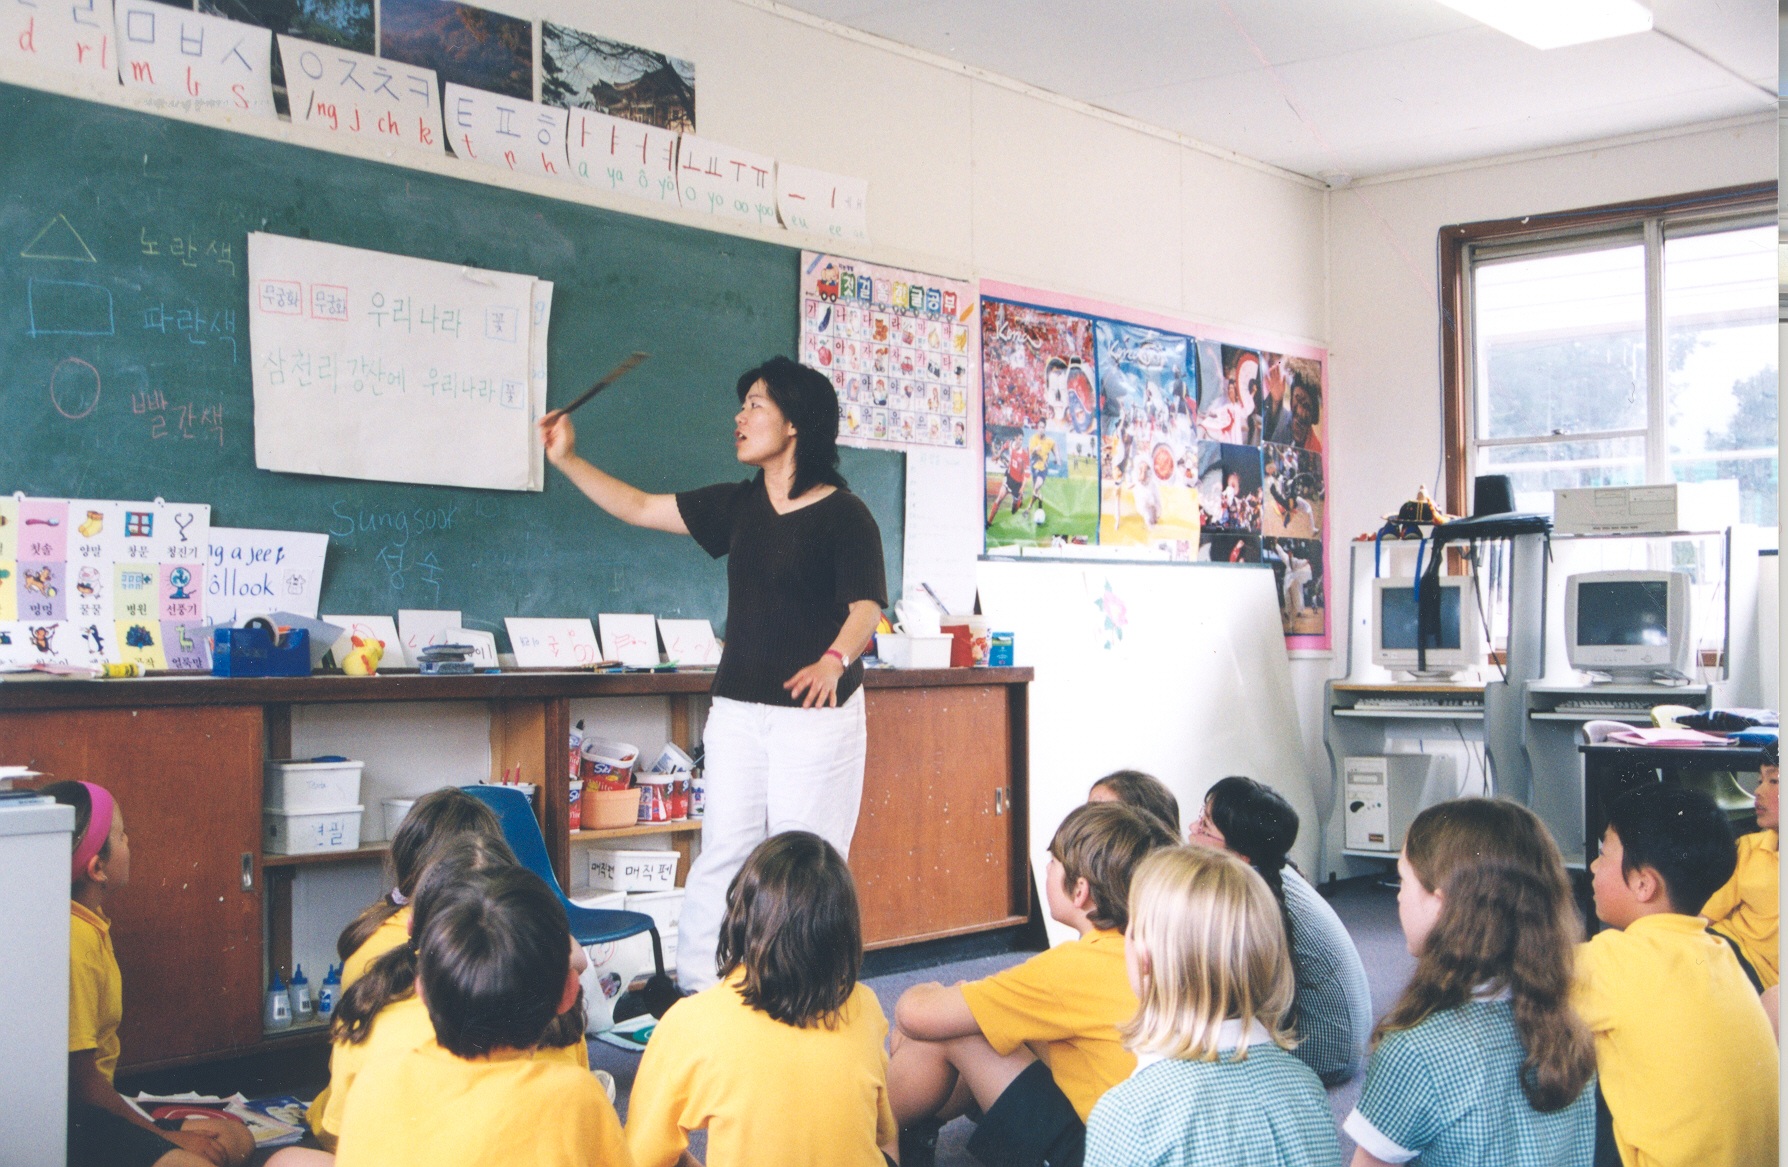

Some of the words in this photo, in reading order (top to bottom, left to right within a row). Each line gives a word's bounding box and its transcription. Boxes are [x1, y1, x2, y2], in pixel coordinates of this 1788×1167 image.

[19, 17, 36, 53] d
[131, 61, 155, 85] m
[349, 103, 361, 132] j
[378, 111, 400, 136] ch
[419, 117, 433, 145] k
[462, 134, 477, 159] t
[578, 161, 589, 178] a
[606, 166, 624, 188] ya
[141, 227, 236, 277] 노란색
[263, 285, 299, 307] 무궁화
[314, 291, 346, 314] 무궁화
[143, 303, 237, 363] 파란색
[132, 389, 225, 447] 빨간색
[31, 542, 53, 556] 칫솔
[79, 544, 102, 558] 양말
[128, 545, 149, 559] 창문
[30, 602, 53, 616] 멍멍
[126, 602, 148, 616] 병원
[594, 763, 611, 774] Ski
[625, 864, 673, 882] 매직펜
